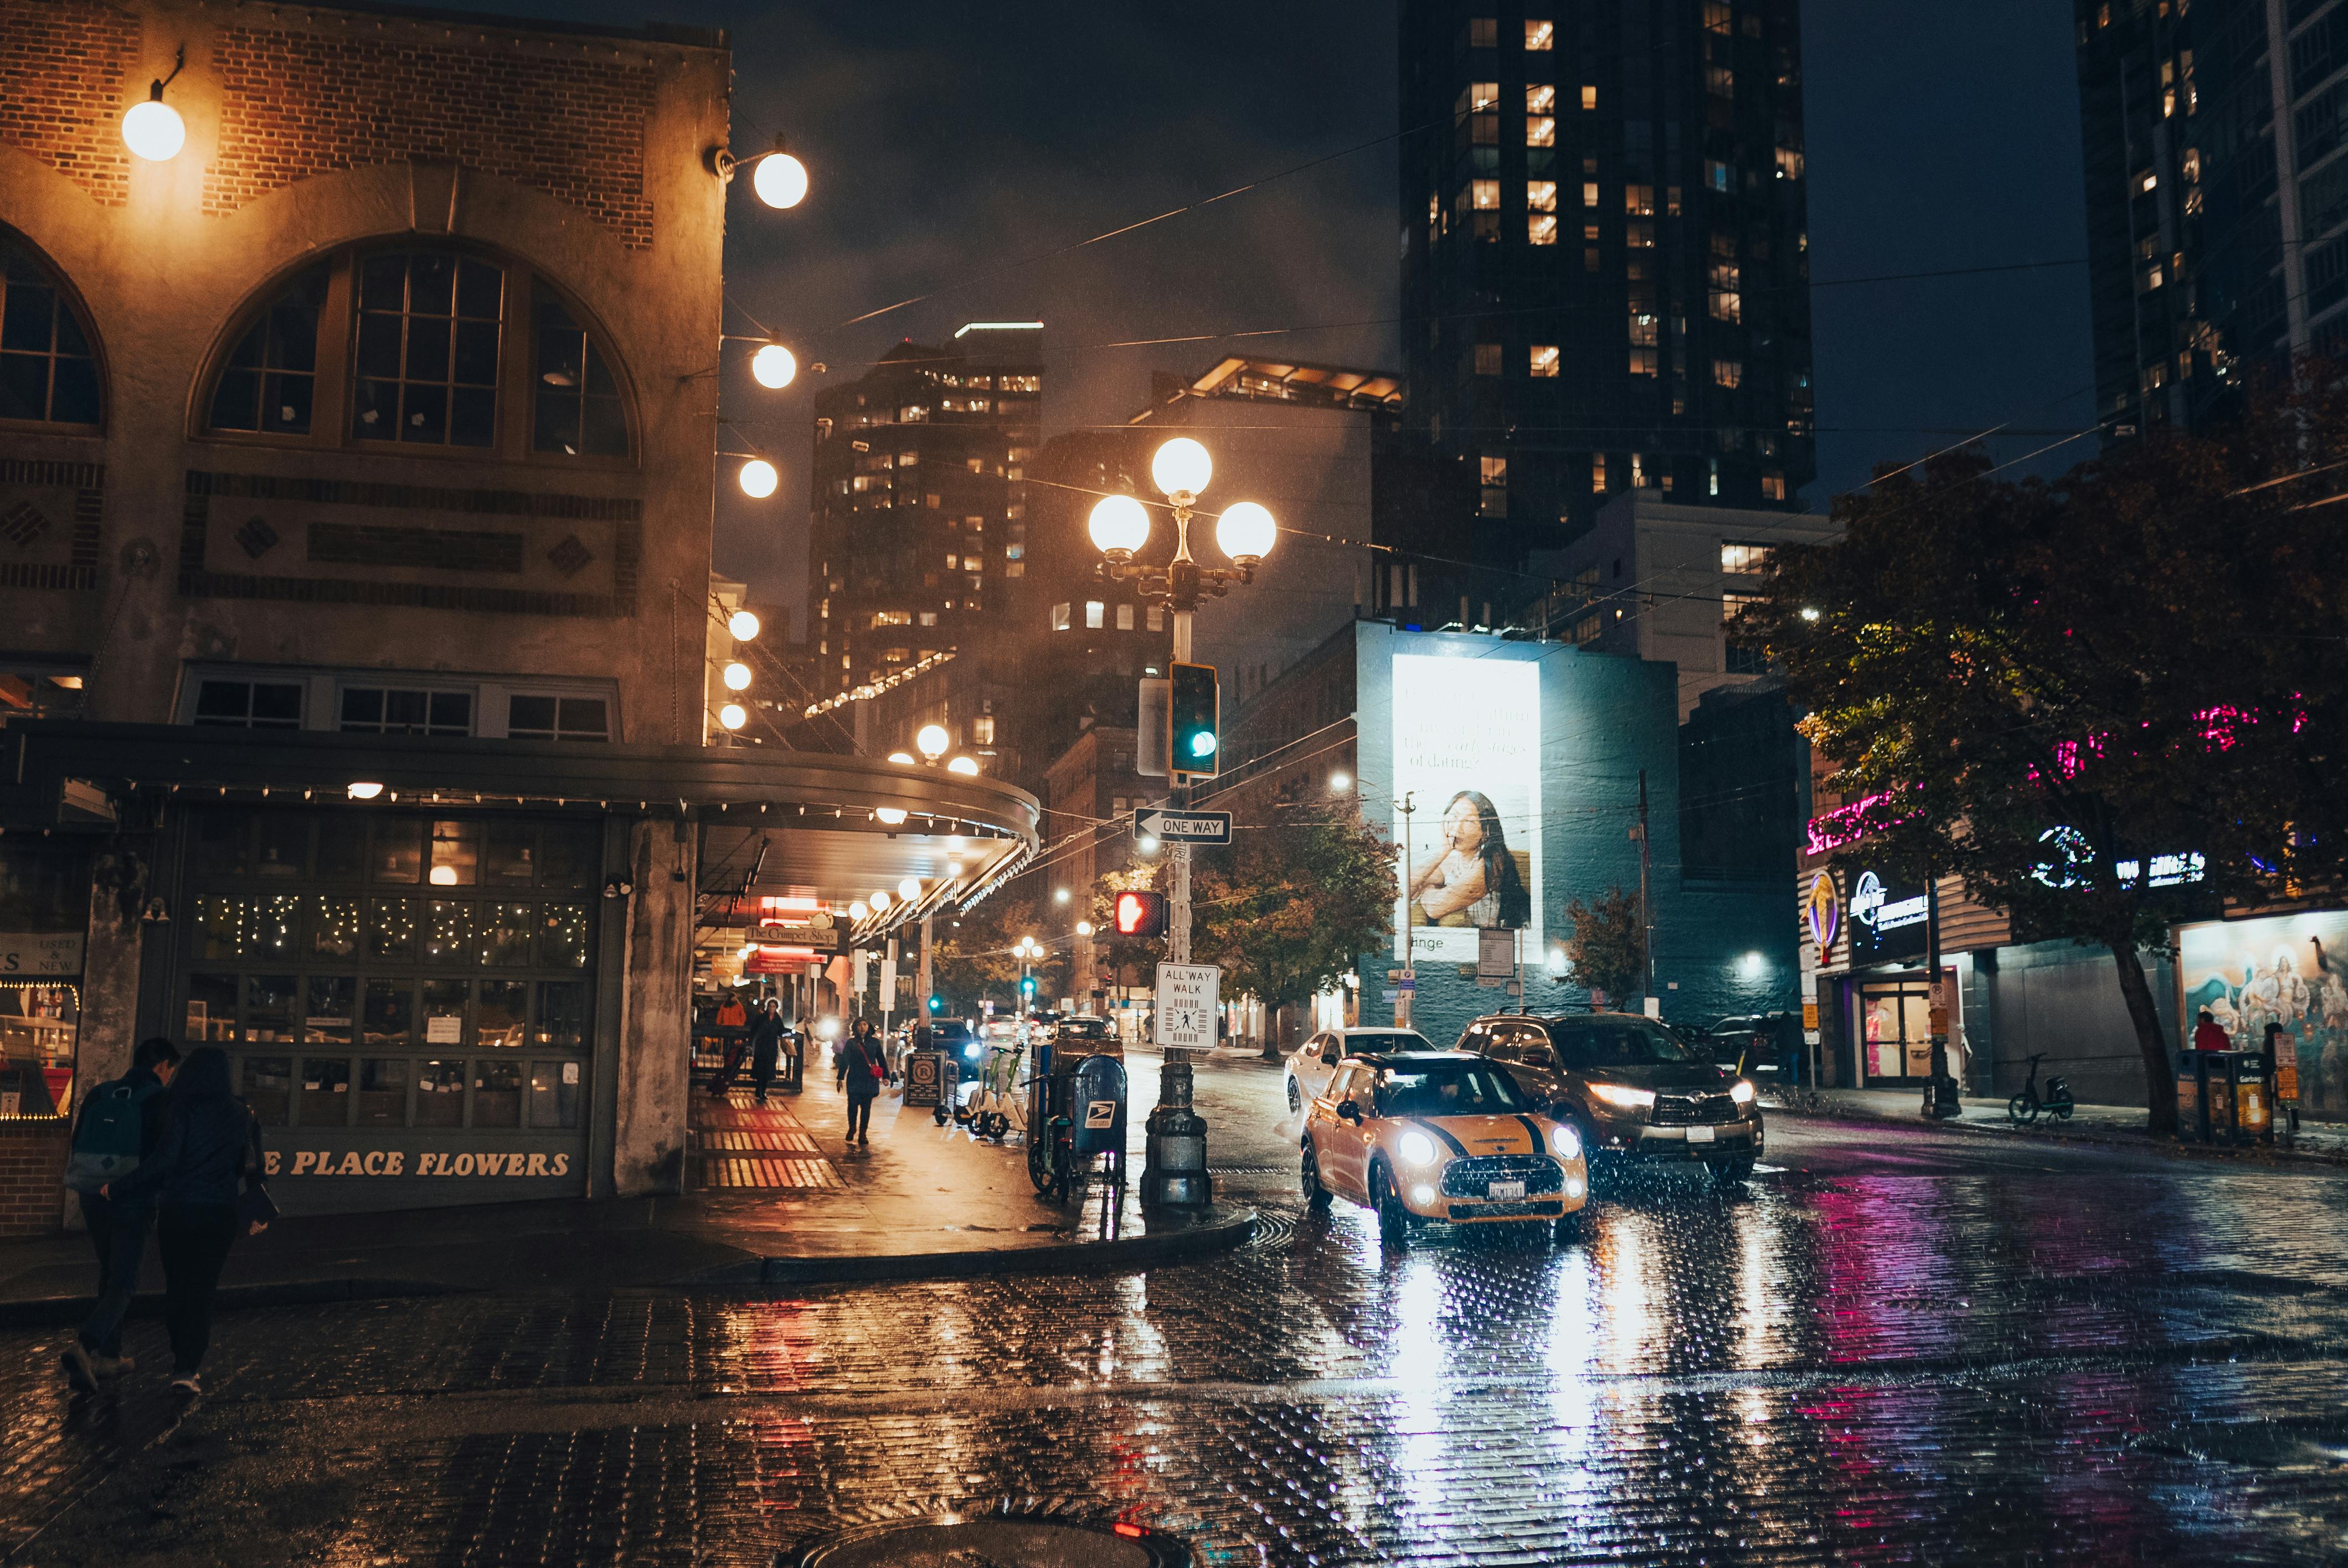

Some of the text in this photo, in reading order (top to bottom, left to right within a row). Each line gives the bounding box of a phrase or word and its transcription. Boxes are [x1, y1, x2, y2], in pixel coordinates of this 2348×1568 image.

[1410, 752, 1479, 771] of dating?
[1163, 820, 1220, 833] ONE WAY
[749, 927, 834, 944] The Crumpet Shop
[39, 939, 75, 948] USED
[50, 951, 59, 959] &
[0, 953, 19, 971] S
[39, 961, 73, 971] NEW
[1166, 970, 1211, 982] ALL WAY
[1174, 984, 1201, 994] WALK
[2239, 1075, 2265, 1084] Garbage
[290, 1151, 404, 1176] PLACE
[415, 1153, 569, 1177] FLOWERS
